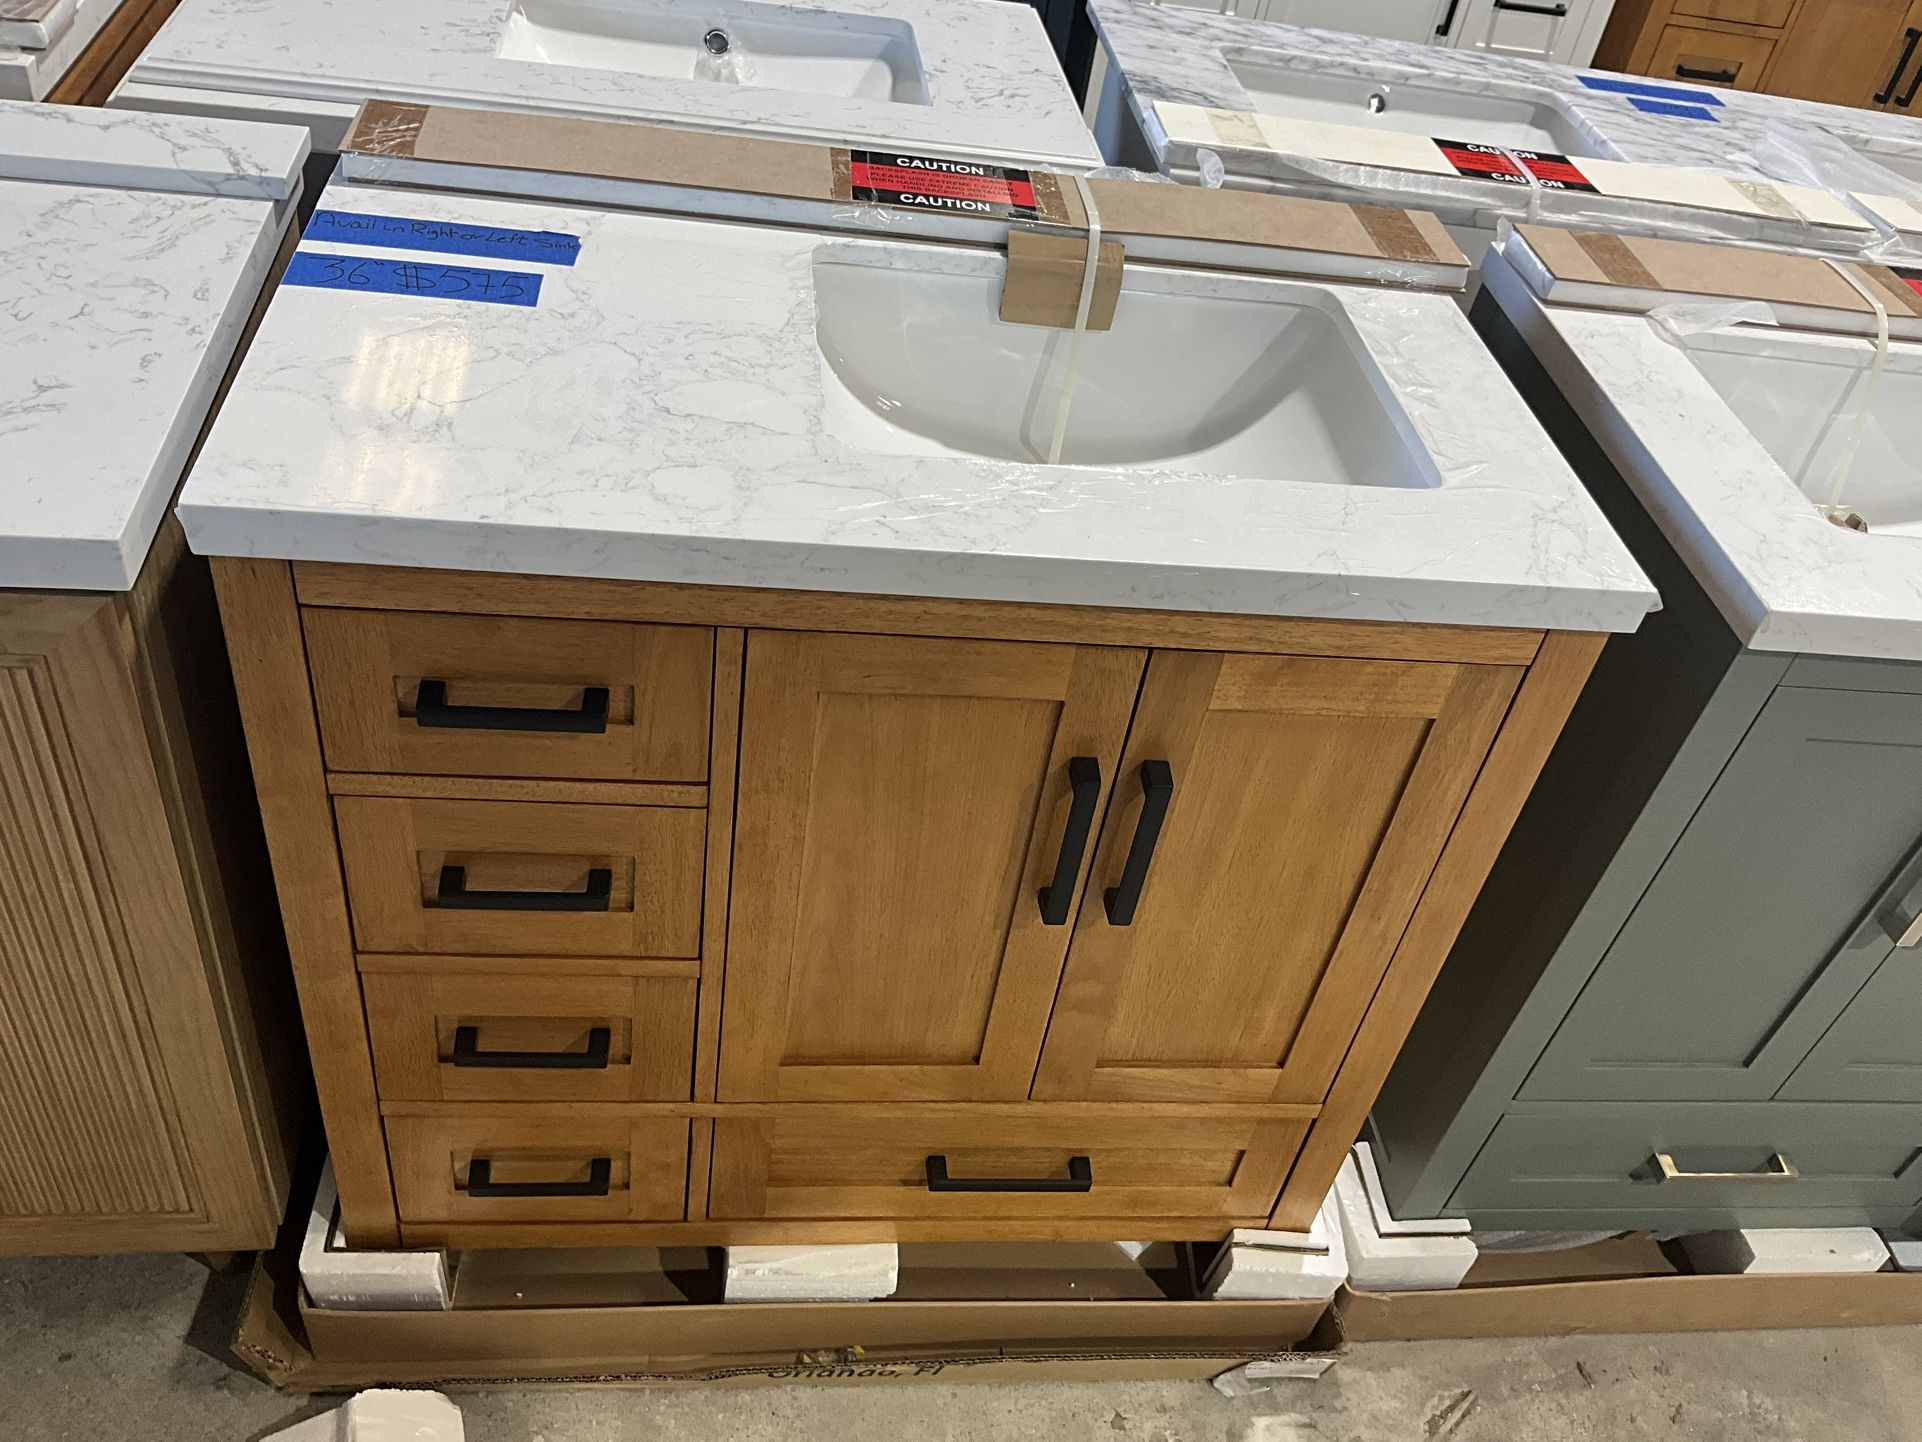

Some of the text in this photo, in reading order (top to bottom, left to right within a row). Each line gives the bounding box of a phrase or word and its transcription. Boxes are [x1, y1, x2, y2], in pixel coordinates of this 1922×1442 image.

[1466, 144, 1538, 160] CAUON
[868, 165, 930, 176] BACKSPLASH
[942, 173, 980, 182] BROKEN
[896, 158, 984, 176] CAUTION
[866, 176, 894, 184] WHEN
[896, 179, 943, 189] HANDLING
[966, 187, 1020, 198] INSTALLING
[870, 171, 906, 180] PLEASE
[928, 178, 972, 187] EXTREME
[973, 183, 1014, 192] CAUTION
[1490, 172, 1566, 189] CAUON
[924, 187, 987, 198] BACKSPLASH
[899, 193, 991, 212] CAUTION
[313, 210, 577, 250] Avail in Right or Left Sink
[393, 264, 530, 299] $575
